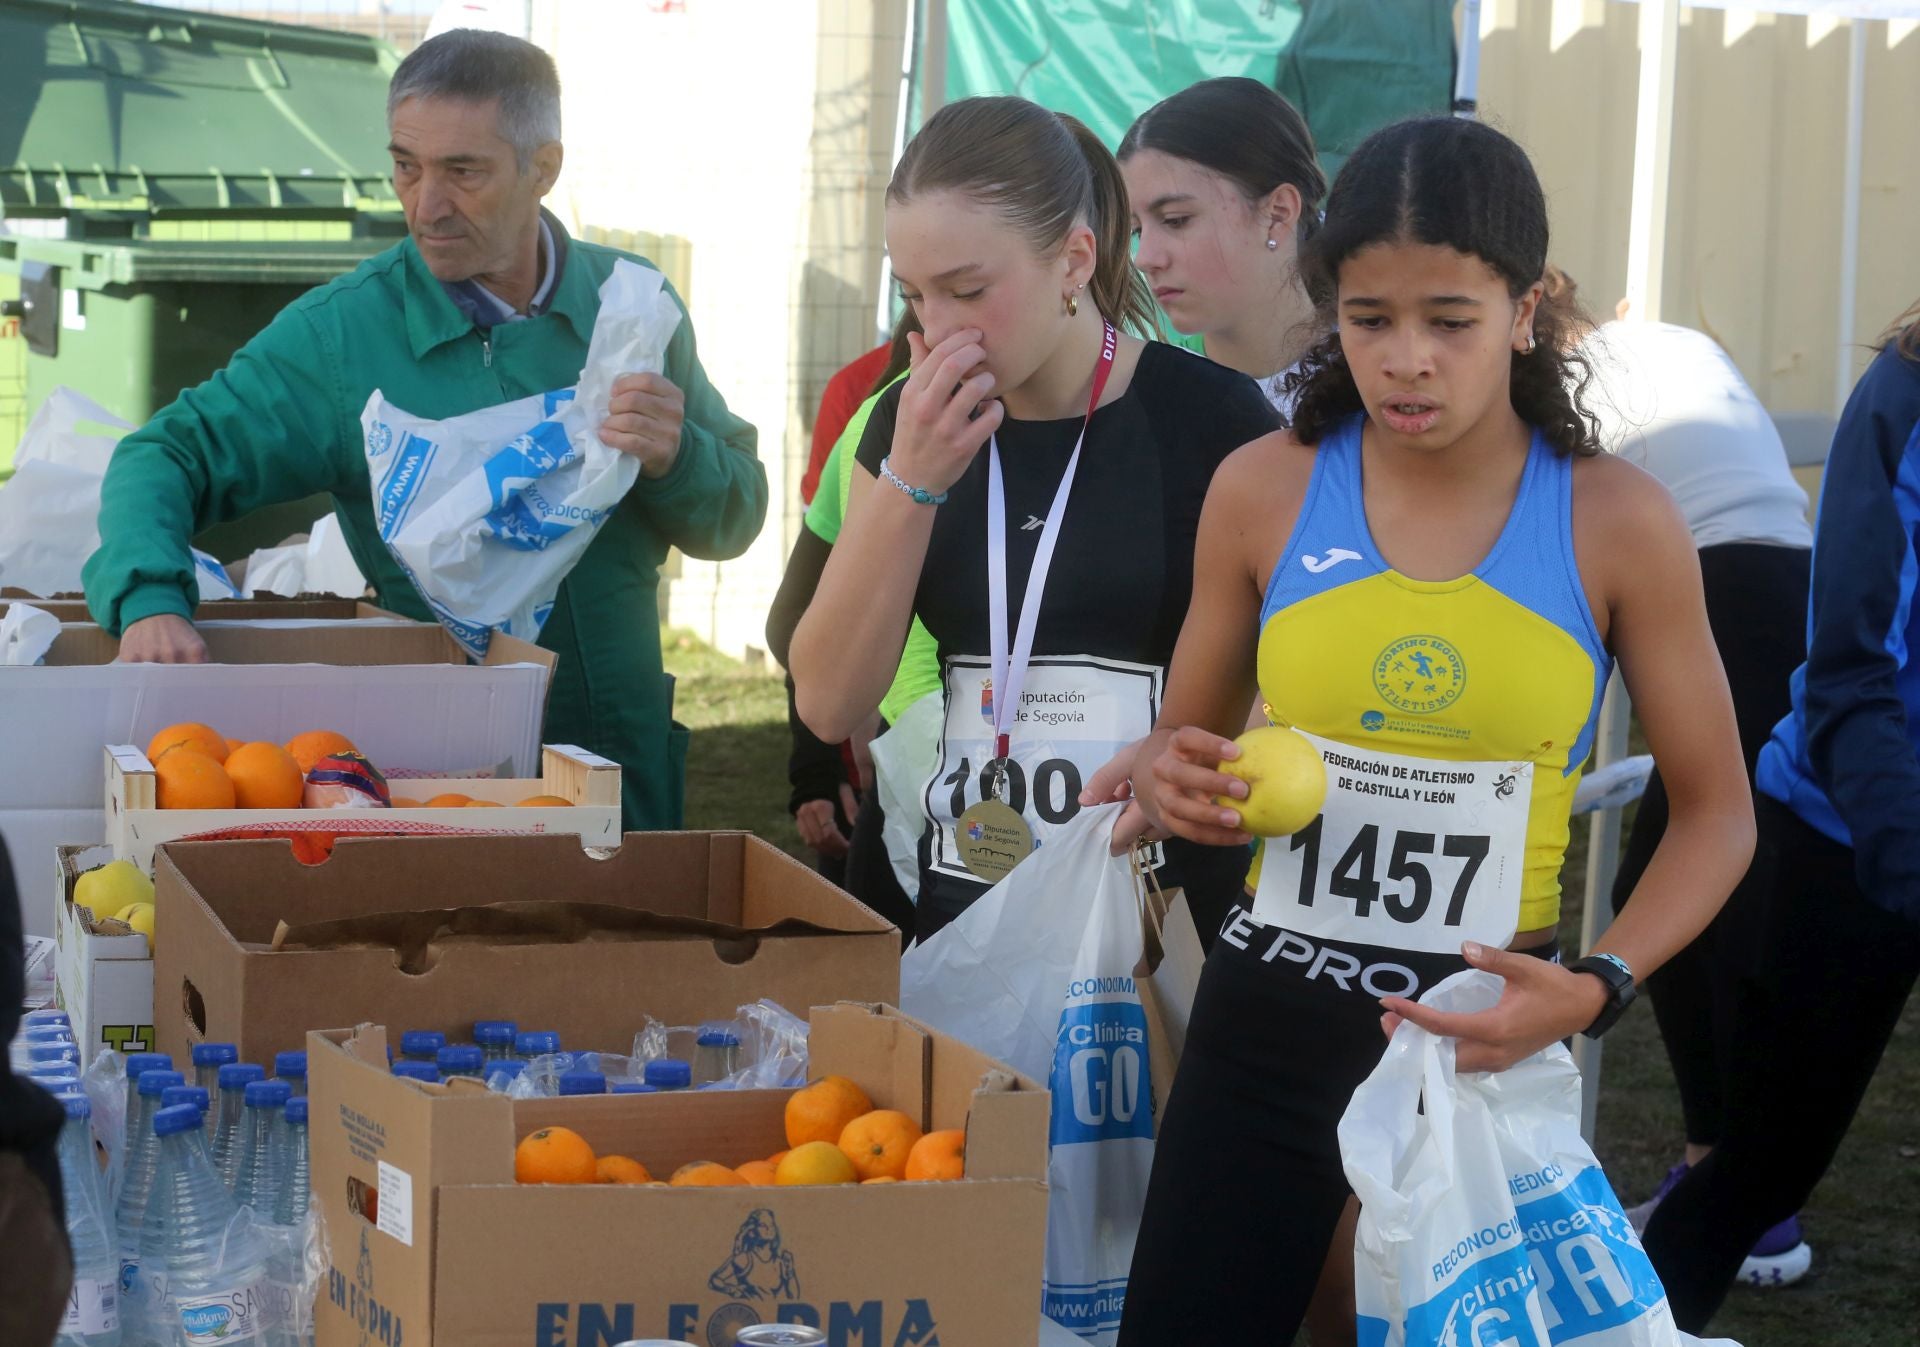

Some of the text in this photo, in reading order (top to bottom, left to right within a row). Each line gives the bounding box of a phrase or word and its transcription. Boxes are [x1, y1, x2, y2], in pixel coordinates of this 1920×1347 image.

[1103, 316, 1116, 361] DIPU
[1378, 639, 1461, 681] SPORTING SEGOVIA
[1018, 690, 1085, 707] iputación
[1379, 682, 1456, 711] ATLETISMO
[1032, 709, 1085, 727] Segovia
[1322, 750, 1475, 785] FEDERACIÓN DE ATLETISMO
[1337, 776, 1456, 805] DE CASTILLA Y LEÓN
[1289, 812, 1491, 927] 1457
[1260, 930, 1420, 1000] PRO
[536, 1302, 635, 1347] EN
